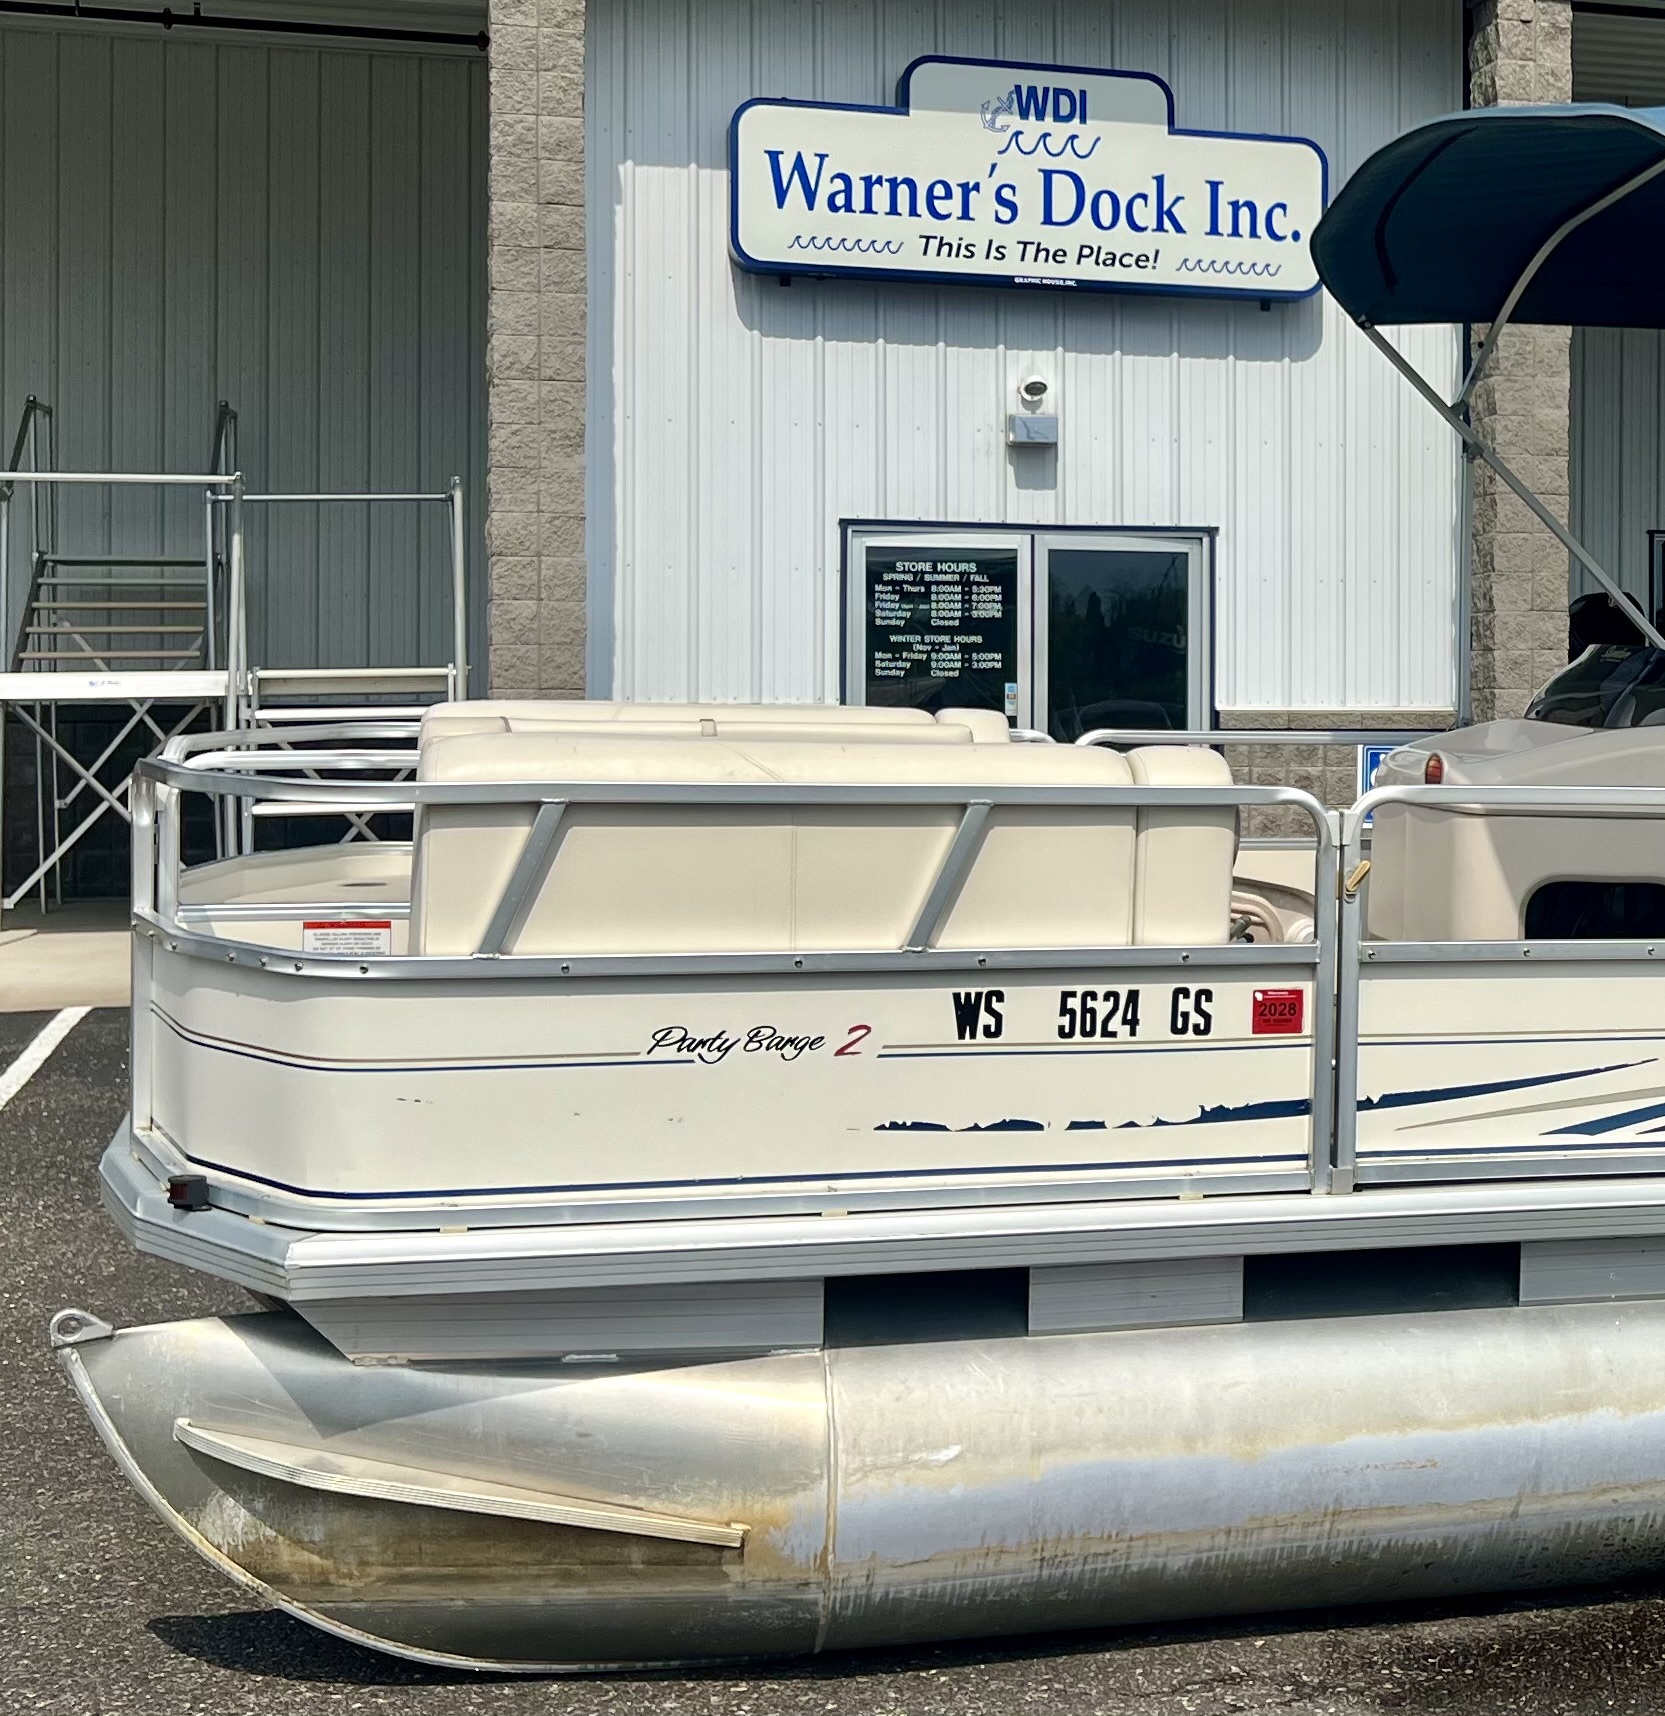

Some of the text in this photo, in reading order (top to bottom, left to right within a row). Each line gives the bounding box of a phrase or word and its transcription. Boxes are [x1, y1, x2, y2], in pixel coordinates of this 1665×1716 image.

[1014, 84, 1088, 125] WDI
[763, 149, 1301, 243] Warner's Dock Inc.
[919, 235, 1160, 270] This Is The Place!
[895, 561, 978, 573] STORE HOURS
[882, 573, 914, 582] SPRING
[924, 573, 960, 582] SUMMER
[970, 574, 990, 583] FALL
[874, 584, 893, 592] Mon
[902, 584, 926, 593] Thurs
[874, 593, 900, 602] Friday
[874, 601, 900, 610] Friday
[874, 610, 912, 619] Saturday
[874, 618, 960, 627] Sunday Closed
[888, 634, 983, 644] WINTER STORE HOURS
[874, 652, 893, 660] Mon
[902, 652, 928, 661] Friday
[874, 660, 912, 669] Saturday
[874, 669, 960, 678] Sunday Closed
[951, 986, 1214, 1041] WS 5624 GS
[1258, 1002, 1297, 1017] 2028
[646, 1024, 872, 1065] Party Barge 2
